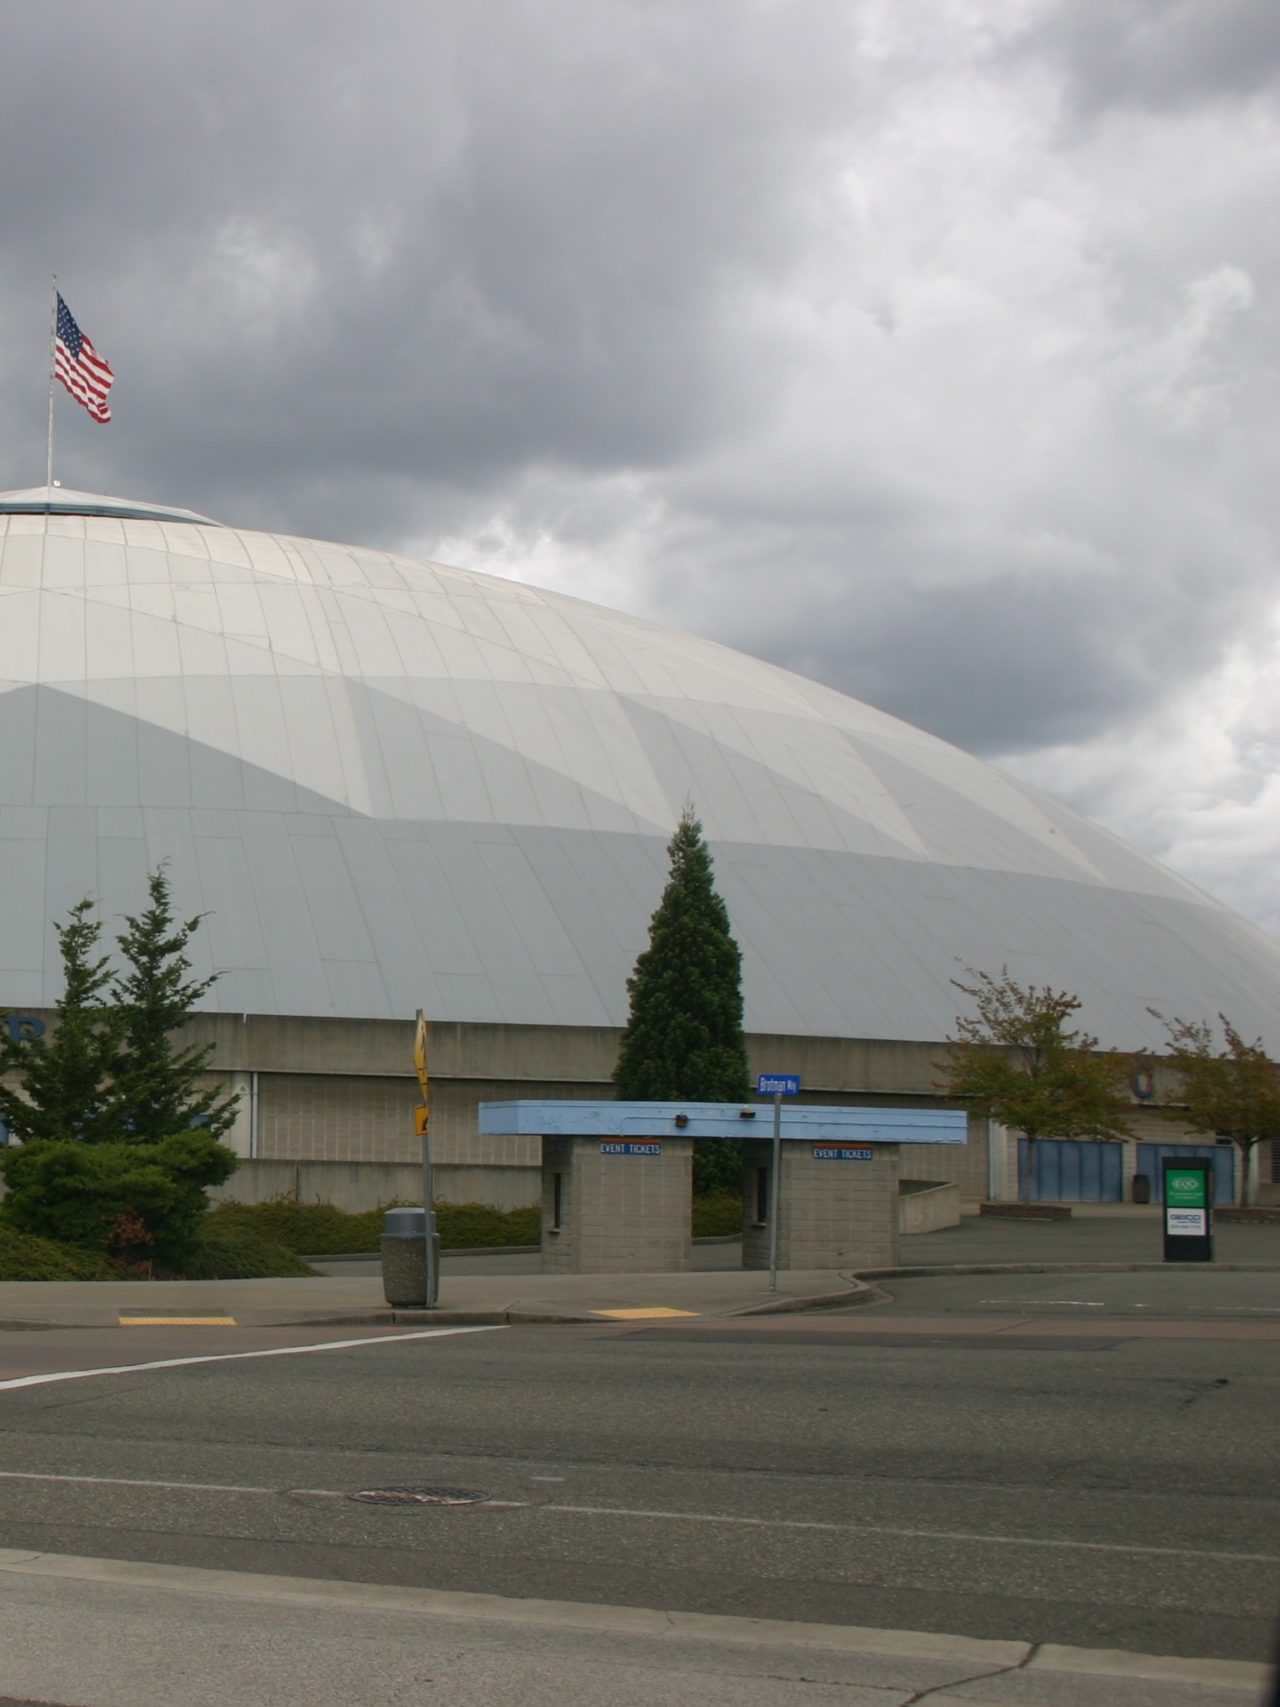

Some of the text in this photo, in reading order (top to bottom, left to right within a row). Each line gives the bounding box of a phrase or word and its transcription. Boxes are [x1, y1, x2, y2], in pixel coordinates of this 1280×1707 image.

[600, 1143, 660, 1154] EVENT TICKETS
[814, 1148, 872, 1159] EVENT TICKETS
